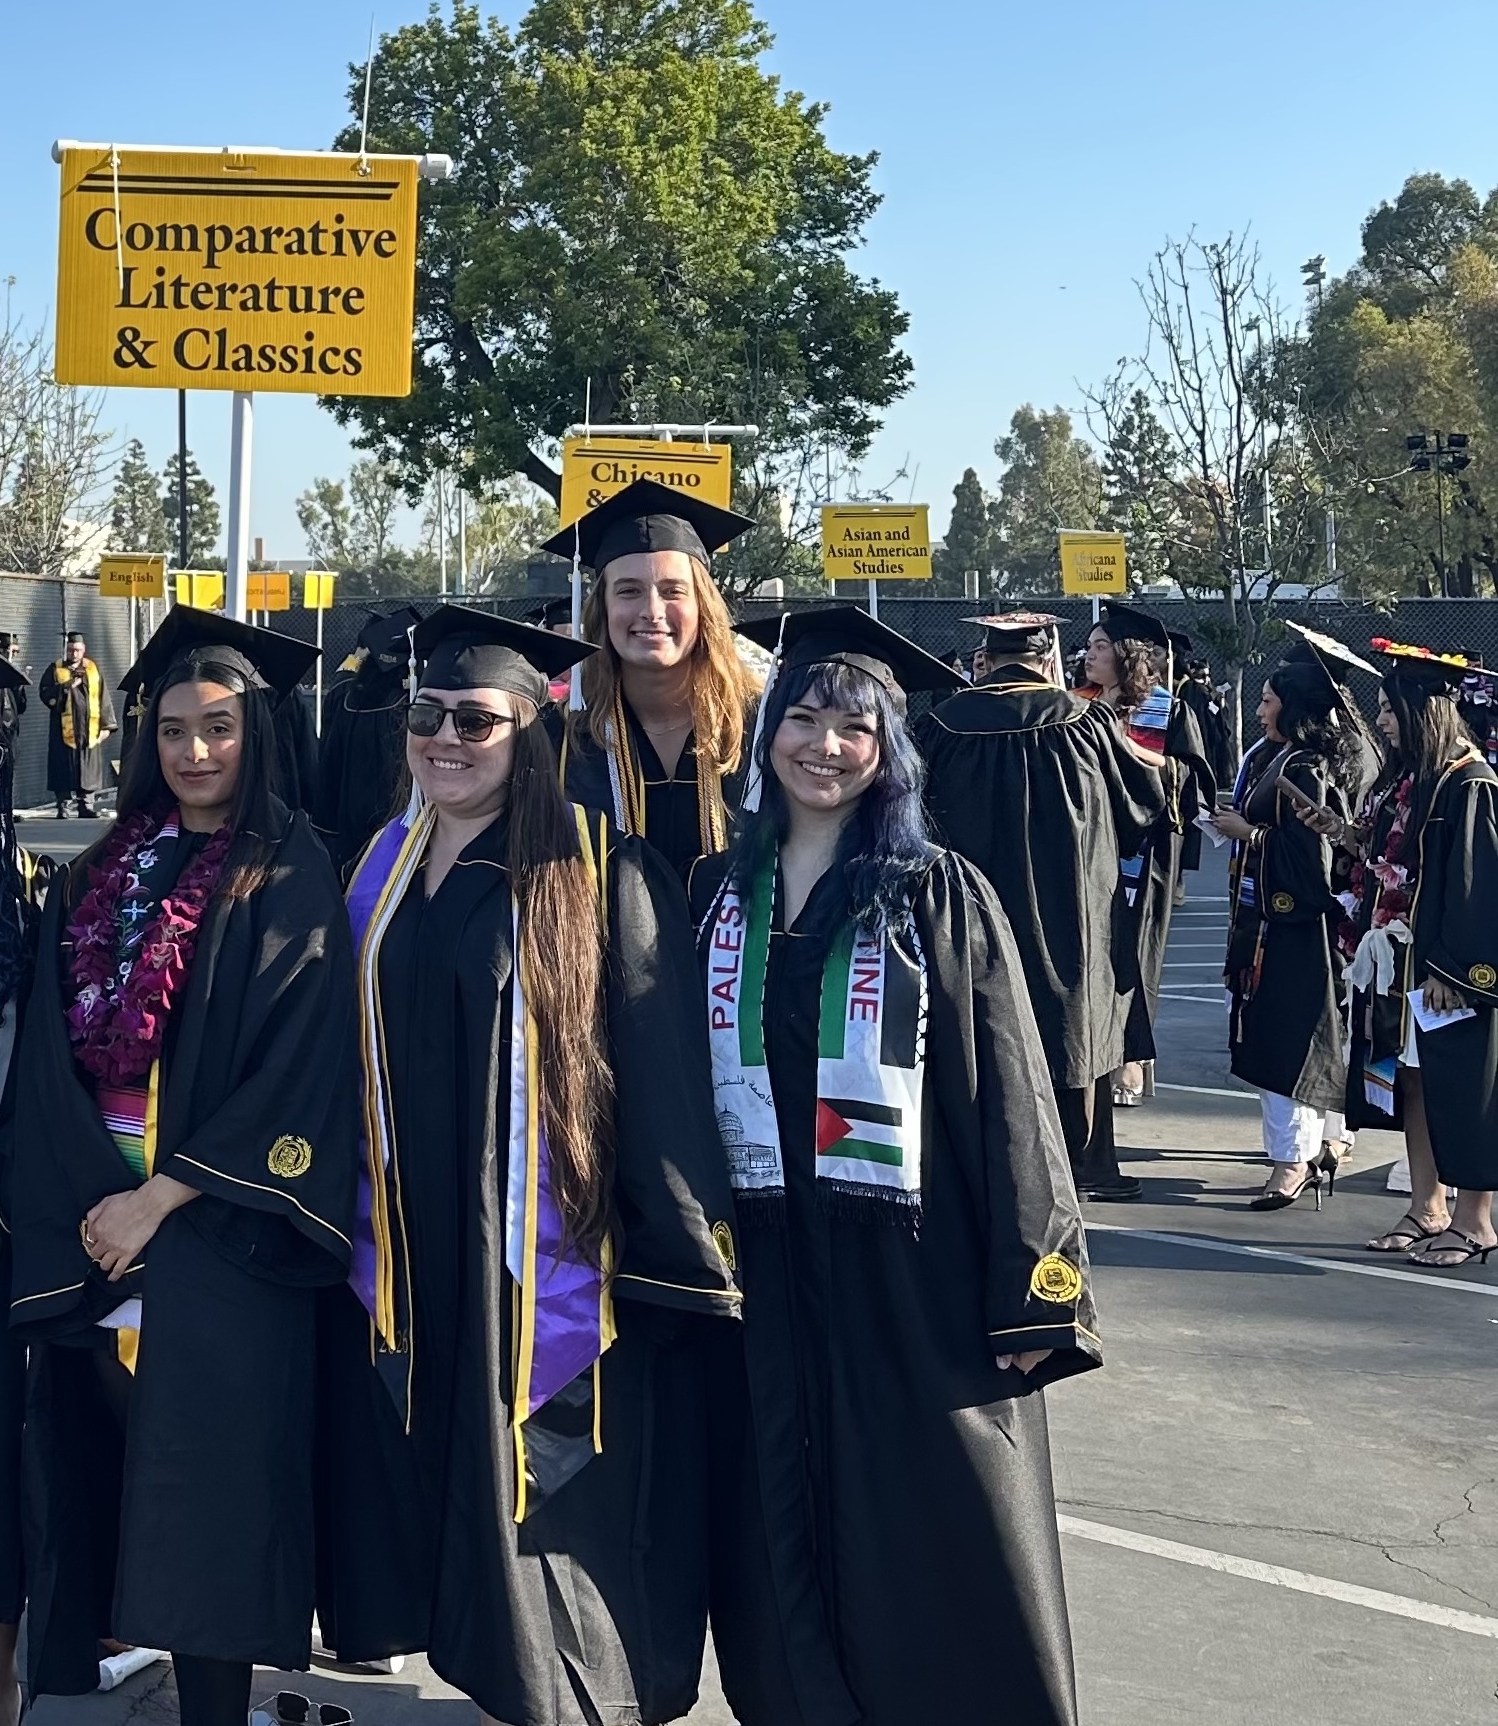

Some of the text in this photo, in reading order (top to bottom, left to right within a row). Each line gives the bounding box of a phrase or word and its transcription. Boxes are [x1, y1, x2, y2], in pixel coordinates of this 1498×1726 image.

[85, 207, 397, 268] Comparative
[115, 266, 366, 316] Literature
[113, 326, 363, 376] & Classics
[590, 462, 701, 488] Chicano
[585, 488, 611, 509] &
[842, 525, 910, 542] Asian and
[826, 542, 929, 558] Asian American
[853, 558, 905, 575] Studies
[109, 571, 154, 586] English
